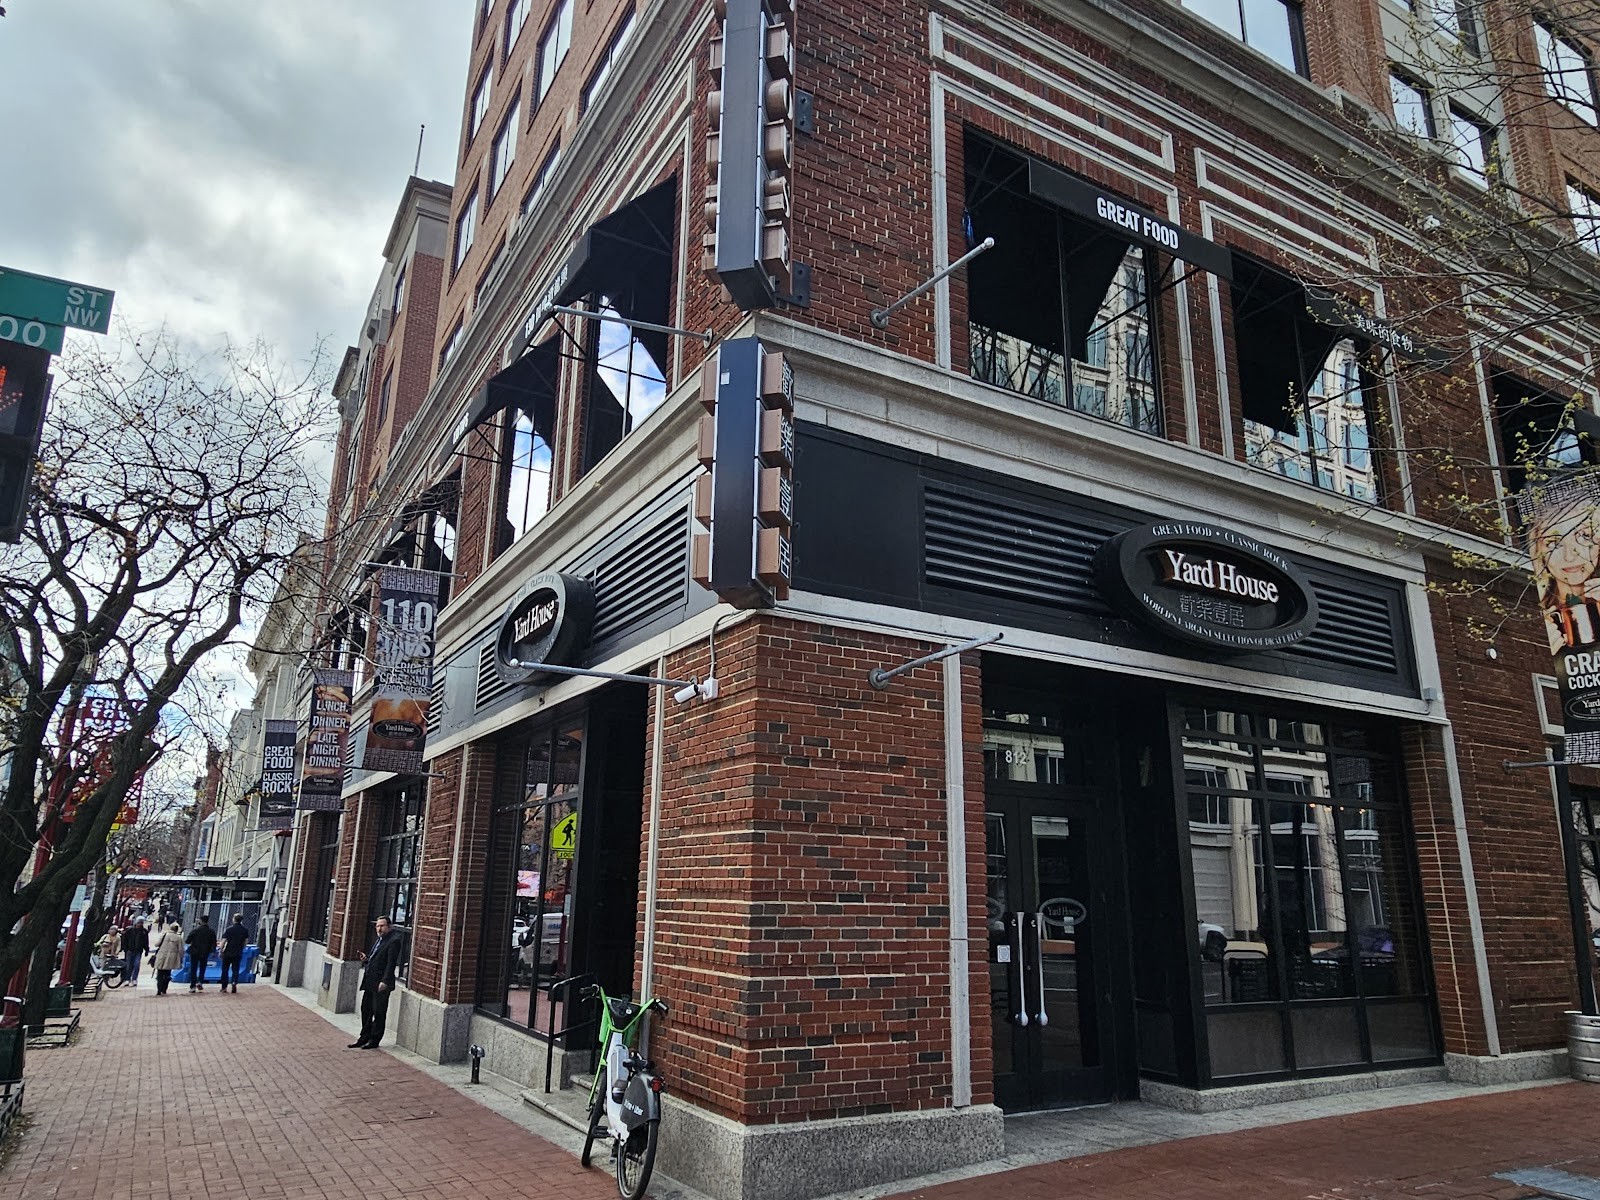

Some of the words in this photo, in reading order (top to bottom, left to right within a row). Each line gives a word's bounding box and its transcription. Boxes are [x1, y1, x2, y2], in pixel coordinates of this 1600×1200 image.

[1097, 197, 1140, 233] GREAT
[1143, 217, 1179, 250] FOOD
[66, 286, 104, 309] ST
[63, 305, 101, 327] NW
[1152, 524, 1183, 537] GREAT
[1185, 524, 1212, 537] FOOD
[1224, 532, 1259, 553] CLASSIC
[1263, 548, 1288, 571] ROCK
[1165, 549, 1214, 589] Yard
[1216, 561, 1279, 603] House
[382, 598, 433, 633] 110
[514, 611, 531, 644] Yard
[530, 600, 555, 633] House
[316, 699, 349, 712] LUNCH.
[312, 715, 349, 729] DINNER.
[317, 732, 339, 744] LATE
[264, 745, 296, 757] GREAT
[312, 743, 340, 756] NIGHT
[1005, 749, 1026, 764] 812
[263, 756, 294, 769] FOOD
[309, 755, 341, 768] DINING
[262, 772, 293, 782] CLASSIC
[262, 781, 292, 793] ROCK
